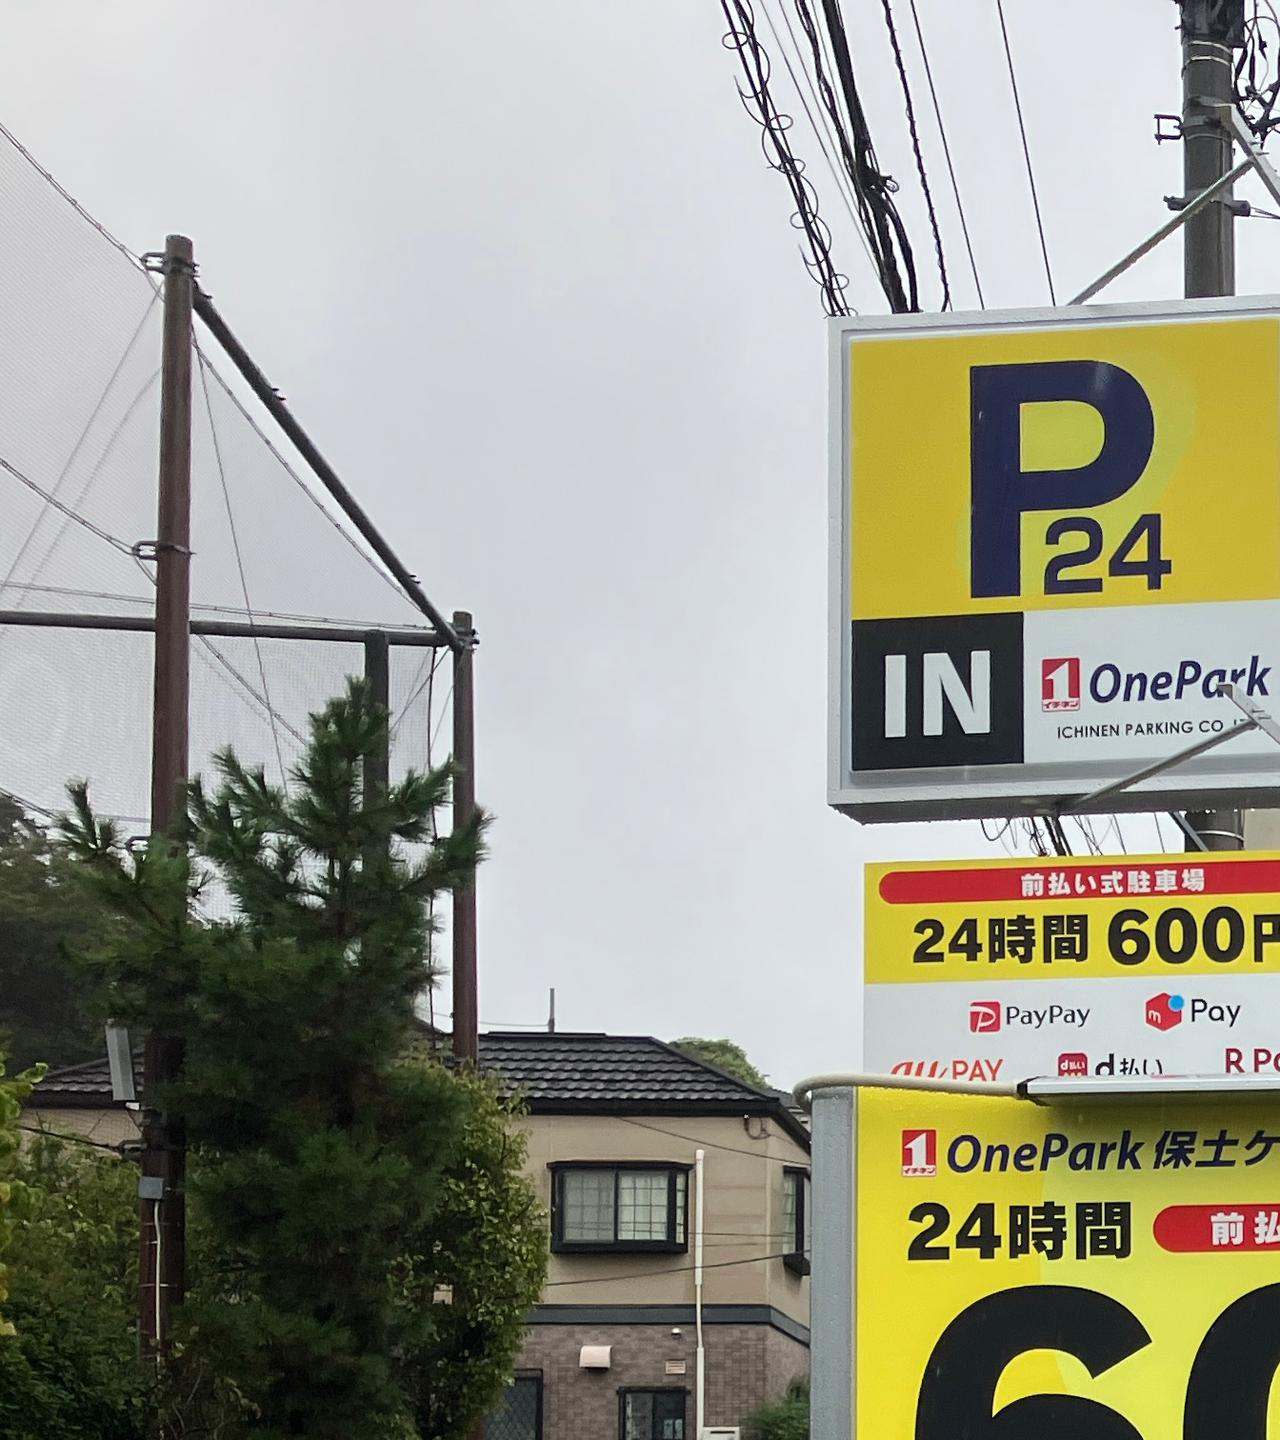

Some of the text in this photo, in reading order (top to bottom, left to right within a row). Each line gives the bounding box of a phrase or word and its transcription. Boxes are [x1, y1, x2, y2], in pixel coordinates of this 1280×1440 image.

[970, 360, 1154, 598] P
[1044, 513, 1172, 595] 24
[884, 650, 990, 738] IN
[1090, 656, 1272, 703] OnePark
[1057, 724, 1120, 739] ICHINEN
[1126, 721, 1193, 736] PARKING
[1020, 868, 1205, 898] 前払い式駐車場
[912, 913, 1089, 965] 24時間
[1006, 1004, 1091, 1029] PayPay
[1191, 999, 1241, 1028] Pay
[953, 1058, 1004, 1082] PAY
[947, 1131, 1144, 1172] OnePark
[907, 1200, 1132, 1261] 24時間
